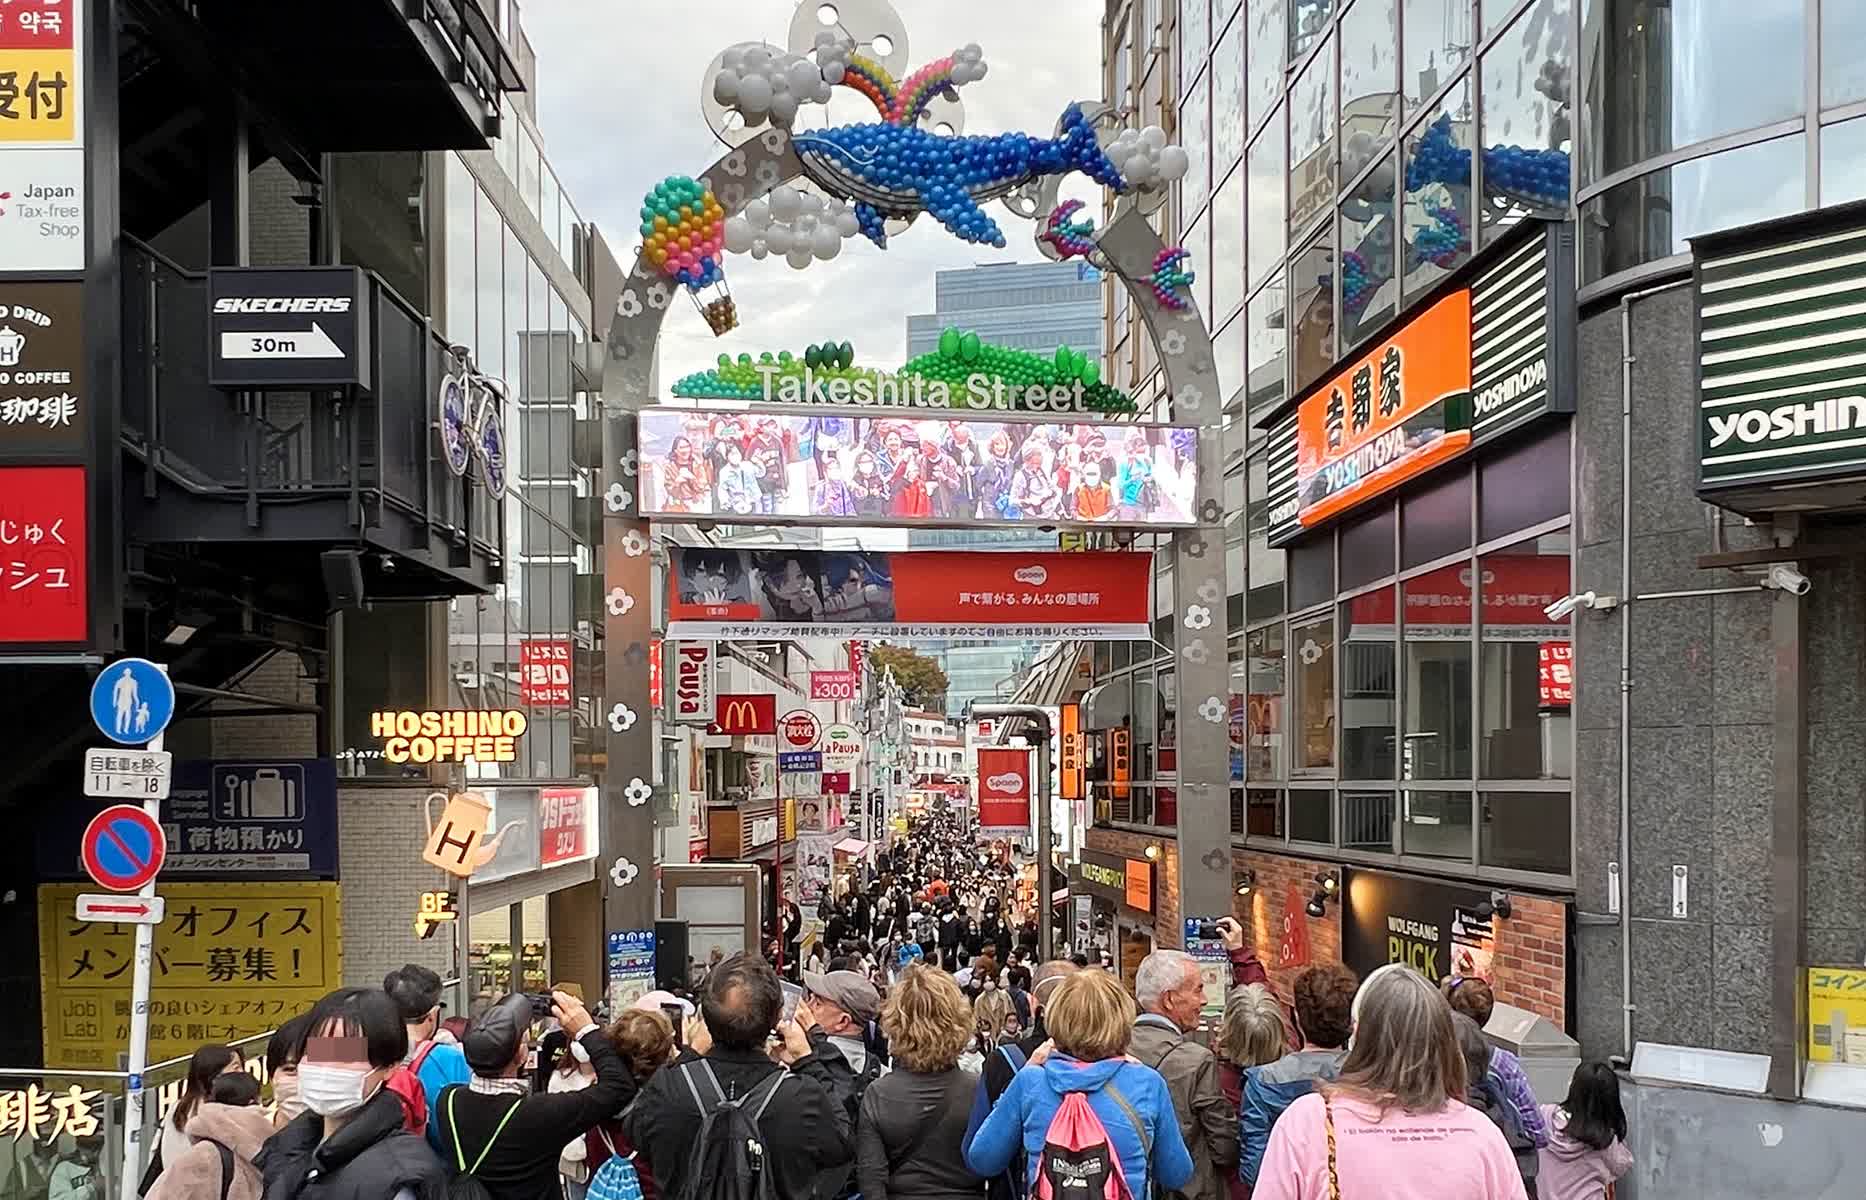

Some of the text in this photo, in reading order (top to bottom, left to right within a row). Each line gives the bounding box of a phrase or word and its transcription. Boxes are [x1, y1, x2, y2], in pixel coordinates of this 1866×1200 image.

[19, 11, 62, 35] 약국
[24, 184, 75, 203] Japan
[16, 204, 79, 218] Tax-free
[39, 222, 80, 237] Shop
[13, 304, 52, 328] DRIP
[213, 298, 351, 313] SKECHERS
[251, 338, 296, 352] 30m
[15, 371, 70, 384] COFFEE
[755, 365, 1088, 412] Takeshita Street
[1473, 358, 1547, 418] YOSHINOYA
[1325, 425, 1408, 493] YOSHINOYA
[0, 561, 70, 590] シュ
[1016, 570, 1045, 580] Spoon
[677, 648, 708, 713] Pausa
[815, 682, 851, 698] ¥300
[371, 710, 526, 737] HOSHINO
[385, 736, 515, 763] COFFEE
[832, 741, 860, 755] Pausa
[95, 775, 110, 791] 11
[145, 777, 159, 793] 18
[989, 778, 1020, 788] Spoon
[187, 826, 304, 850] 荷物預かり
[435, 821, 476, 864] H
[421, 892, 449, 914] BF
[1388, 915, 1439, 942] WOLFGANG
[1389, 935, 1438, 981] PUCK
[63, 1022, 97, 1038] Lab
